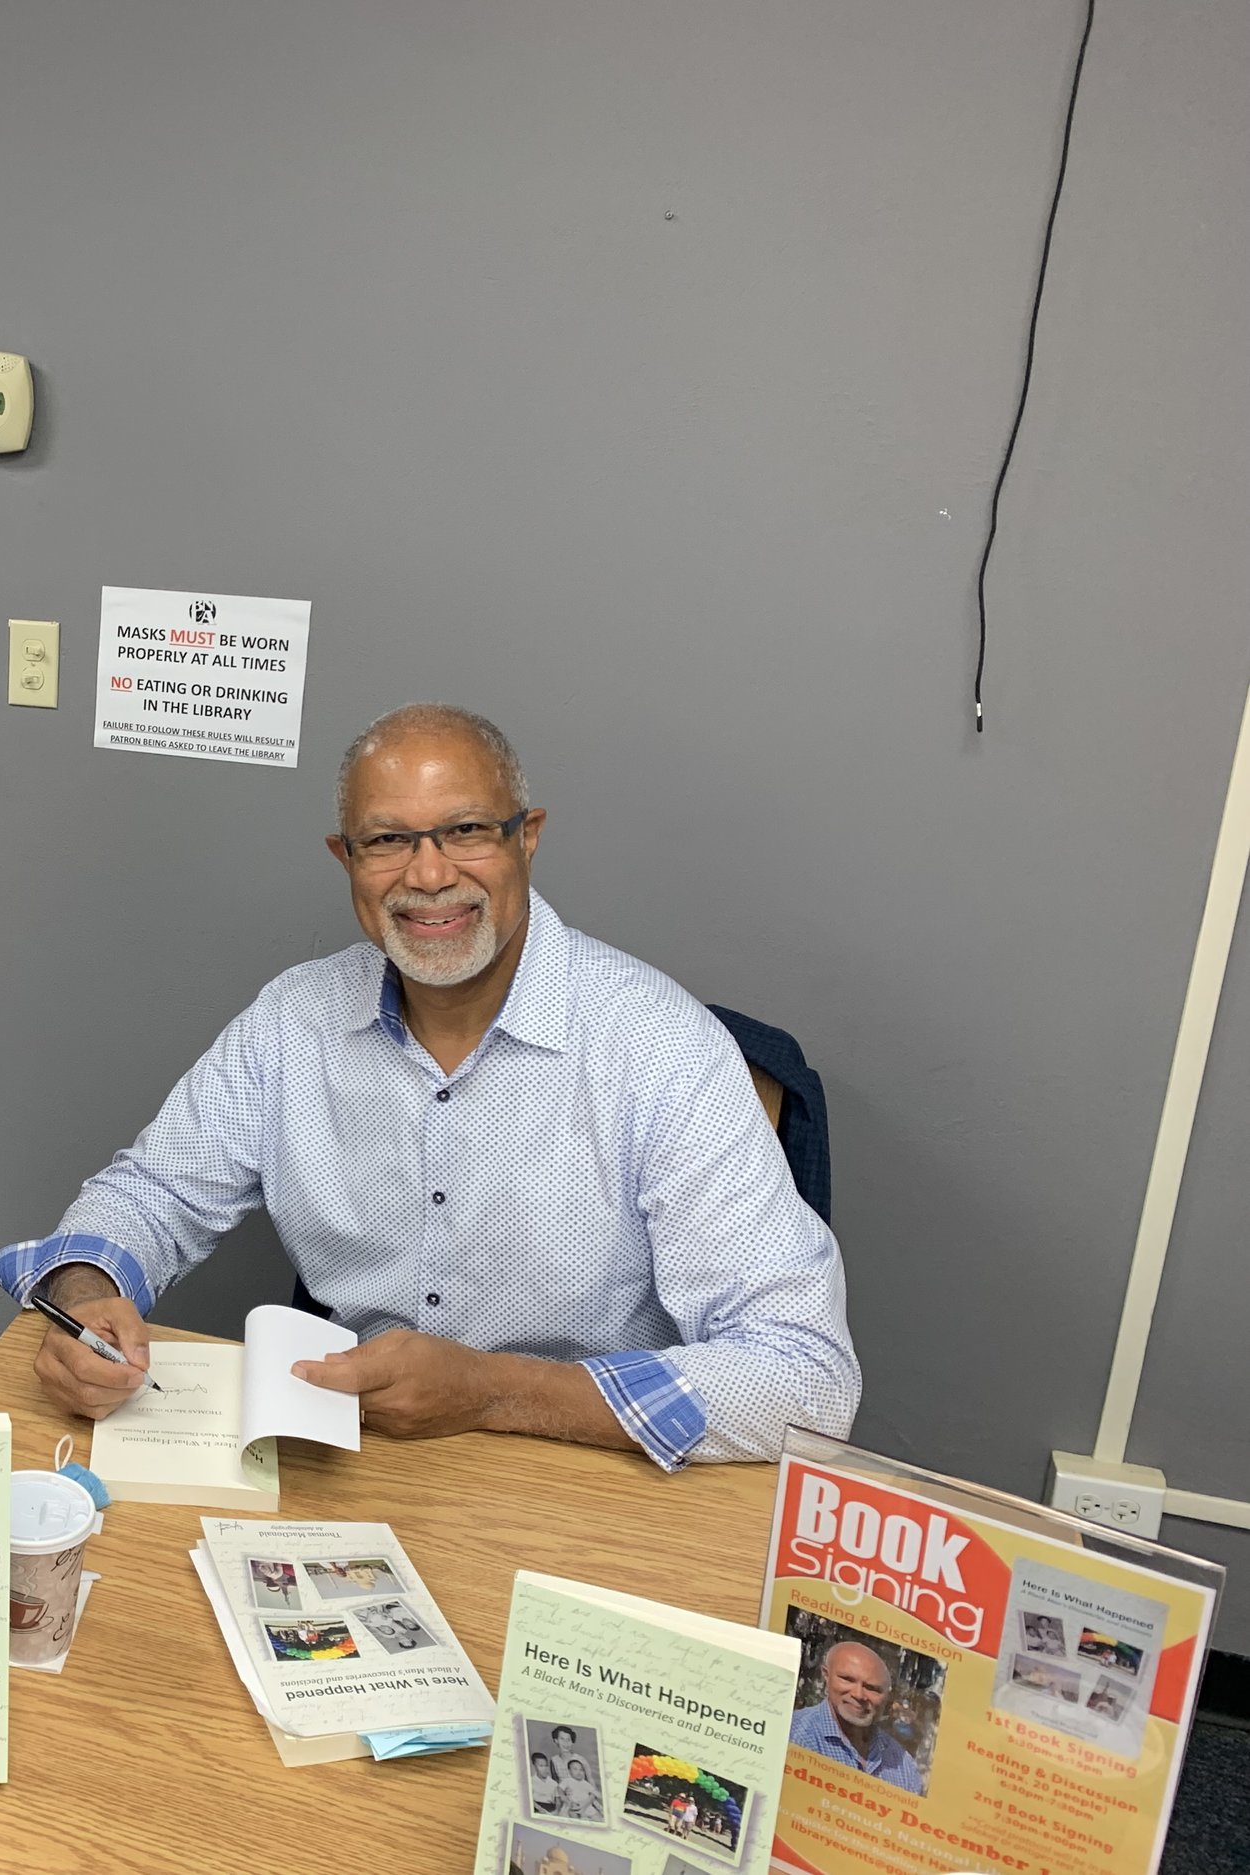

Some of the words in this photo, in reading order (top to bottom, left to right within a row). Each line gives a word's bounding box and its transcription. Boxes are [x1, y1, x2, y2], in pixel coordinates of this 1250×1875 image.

[117, 625, 166, 642] MASKS
[170, 629, 216, 646] MUST
[219, 634, 237, 647] BE
[241, 636, 290, 652] WORN
[117, 645, 188, 664] PROPERLY
[191, 652, 209, 666] AT
[212, 654, 237, 669] ALL
[241, 656, 286, 673] TIMES
[111, 676, 133, 690] NO
[136, 678, 187, 695] EATING
[191, 683, 212, 698] OR
[215, 686, 289, 705] DRINKING
[143, 699, 158, 712] IN
[162, 700, 188, 715] THE
[192, 704, 252, 721] LIBRARY
[103, 720, 134, 731] FAILURE
[135, 723, 146, 732] TO
[147, 724, 181, 736] FOLLOW
[182, 728, 206, 738] THESE
[208, 731, 232, 741] RULES
[233, 733, 253, 743] WILL
[255, 736, 285, 747] RESULT
[286, 739, 295, 747] IN
[110, 734, 141, 745] PATRON
[142, 737, 167, 748] BEING
[168, 740, 195, 750] ASKED
[195, 743, 207, 752] TO
[208, 744, 233, 754] LEAVE
[234, 747, 249, 756] THE
[251, 749, 285, 761] LIBRARY
[122, 1436, 170, 1445] Happened
[174, 1439, 200, 1447] What
[214, 1441, 238, 1449] Here
[258, 1531, 306, 1539] MacDonald
[309, 1531, 342, 1539] Thomas
[796, 1472, 971, 1594] Book
[787, 1537, 984, 1648] Signing
[1022, 1579, 1048, 1594] Here
[1051, 1589, 1060, 1599] Is
[1064, 1593, 1093, 1609] What
[1096, 1604, 1154, 1630] Happened
[791, 1588, 855, 1626] Reading
[859, 1615, 871, 1629] &
[875, 1619, 963, 1662] Discussion
[280, 1675, 323, 1687] Decisions
[325, 1673, 344, 1683] and
[345, 1670, 396, 1682] Discoveries
[400, 1667, 427, 1676] Man's
[414, 1677, 429, 1688] Is
[429, 1667, 452, 1675] Black
[432, 1676, 469, 1688] Here
[285, 1683, 366, 1702] Happened
[371, 1679, 412, 1692] What
[524, 1642, 570, 1671] Here
[575, 1657, 592, 1678] Is
[599, 1664, 652, 1699] What
[658, 1682, 767, 1737] Happened
[521, 1665, 531, 1678] A
[533, 1668, 566, 1688] Black
[568, 1678, 604, 1701] Man's
[606, 1689, 674, 1725] Discoveries
[676, 1715, 701, 1735] and
[704, 1723, 765, 1755] Decisions
[985, 1711, 1011, 1729] 1st
[1016, 1723, 1061, 1748] Book
[1067, 1742, 1138, 1779] Signing
[806, 1755, 851, 1782] Thomas
[853, 1775, 919, 1809] MacDonald
[967, 1740, 1031, 1774] Reading
[1035, 1767, 1046, 1779] &
[1051, 1772, 1139, 1814] Discussion
[991, 1763, 1029, 1785] (max.
[1032, 1779, 1050, 1792] 20
[1053, 1787, 1108, 1815] people)
[784, 1764, 892, 1818] ednesday
[899, 1809, 1031, 1872] December
[973, 1791, 1003, 1810] 2nd
[1008, 1804, 1048, 1825] Book
[1052, 1820, 1114, 1855] Signing
[807, 1806, 832, 1822] #13
[835, 1816, 879, 1845] Queen
[883, 1837, 924, 1864] Street
[821, 1798, 893, 1836] Bermuda
[898, 1828, 971, 1866] National
